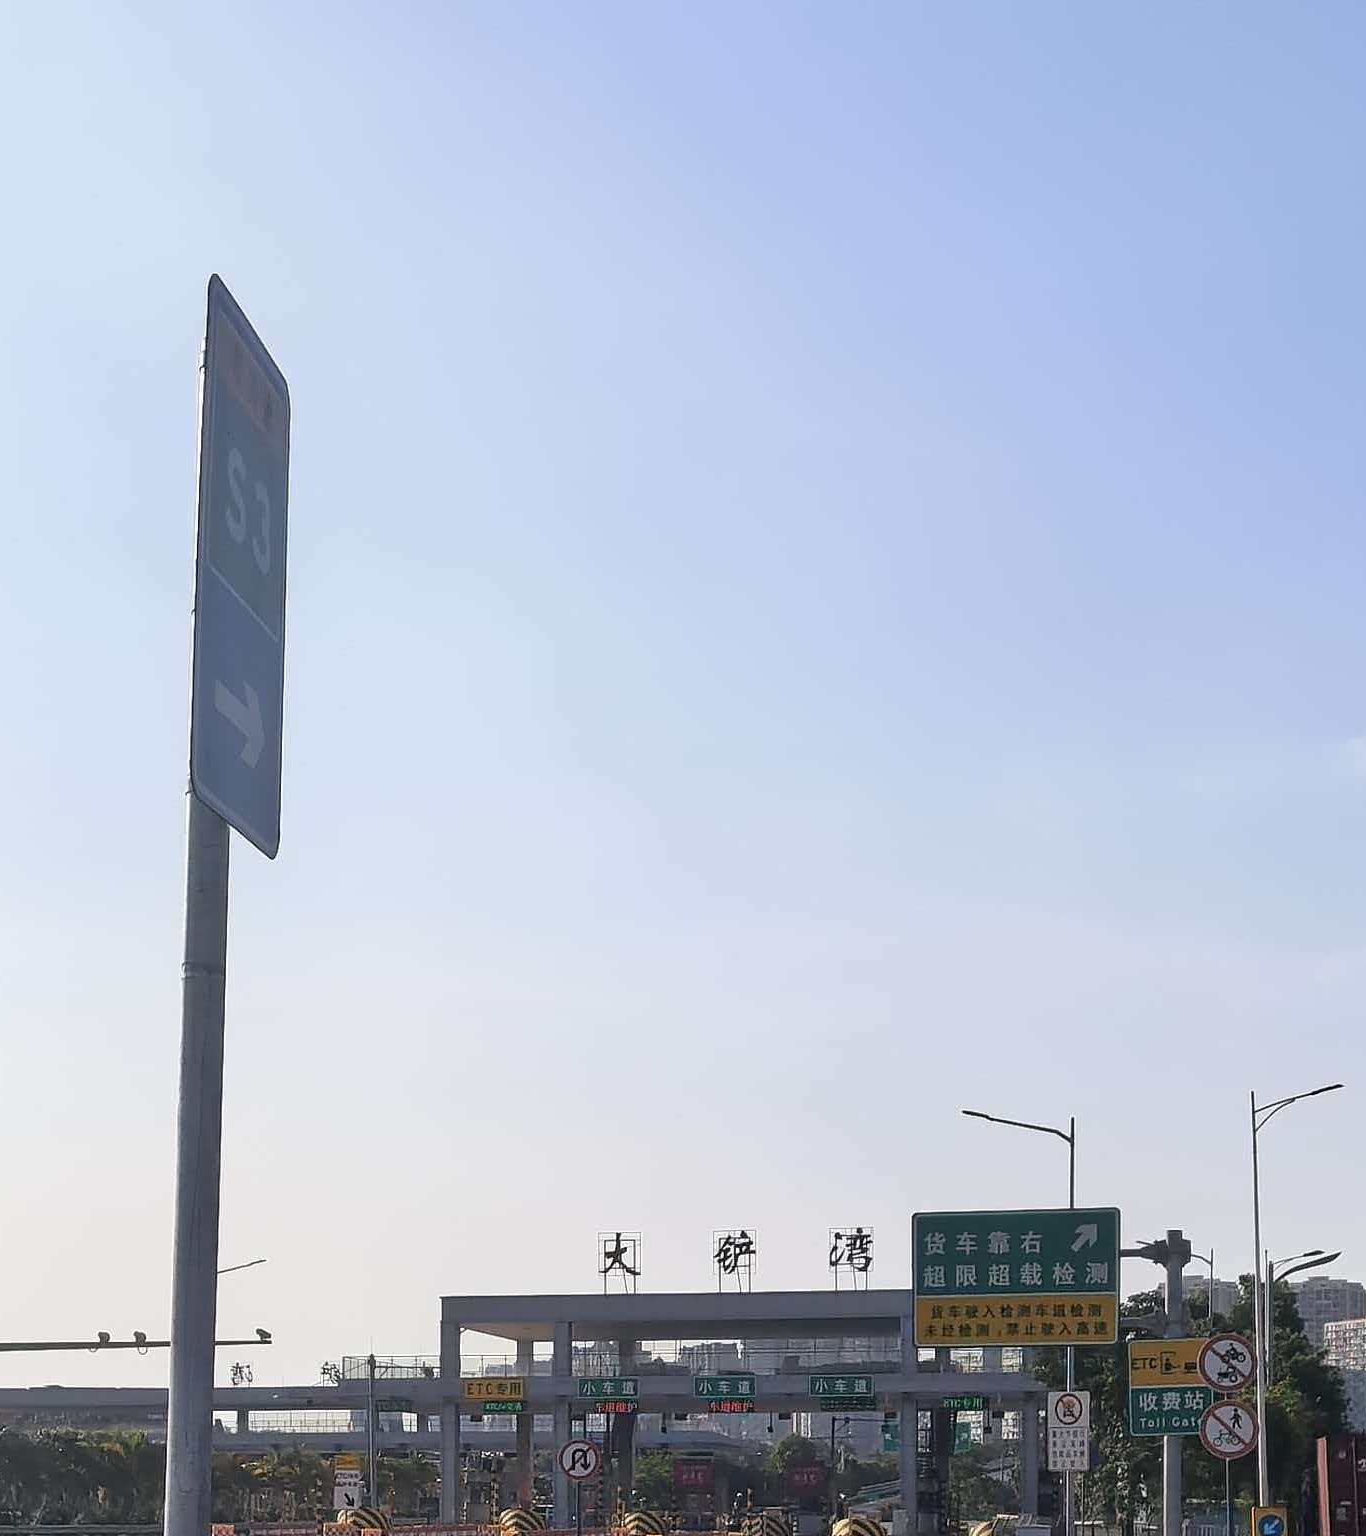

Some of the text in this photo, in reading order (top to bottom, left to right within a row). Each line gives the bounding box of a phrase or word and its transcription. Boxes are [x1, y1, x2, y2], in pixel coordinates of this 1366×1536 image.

[225, 447, 270, 575] S3
[598, 1228, 873, 1276] 大铲湾
[924, 1231, 1043, 1256] 货车靠右
[923, 1262, 1108, 1288] 超限超载检测
[1130, 1358, 1157, 1370] ETC
[582, 1381, 635, 1396] 小车道
[698, 1380, 751, 1394] 小车道
[815, 1378, 868, 1393] 小车道
[1139, 1391, 1204, 1411] 收费站
[1140, 1417, 1166, 1428] Toll
